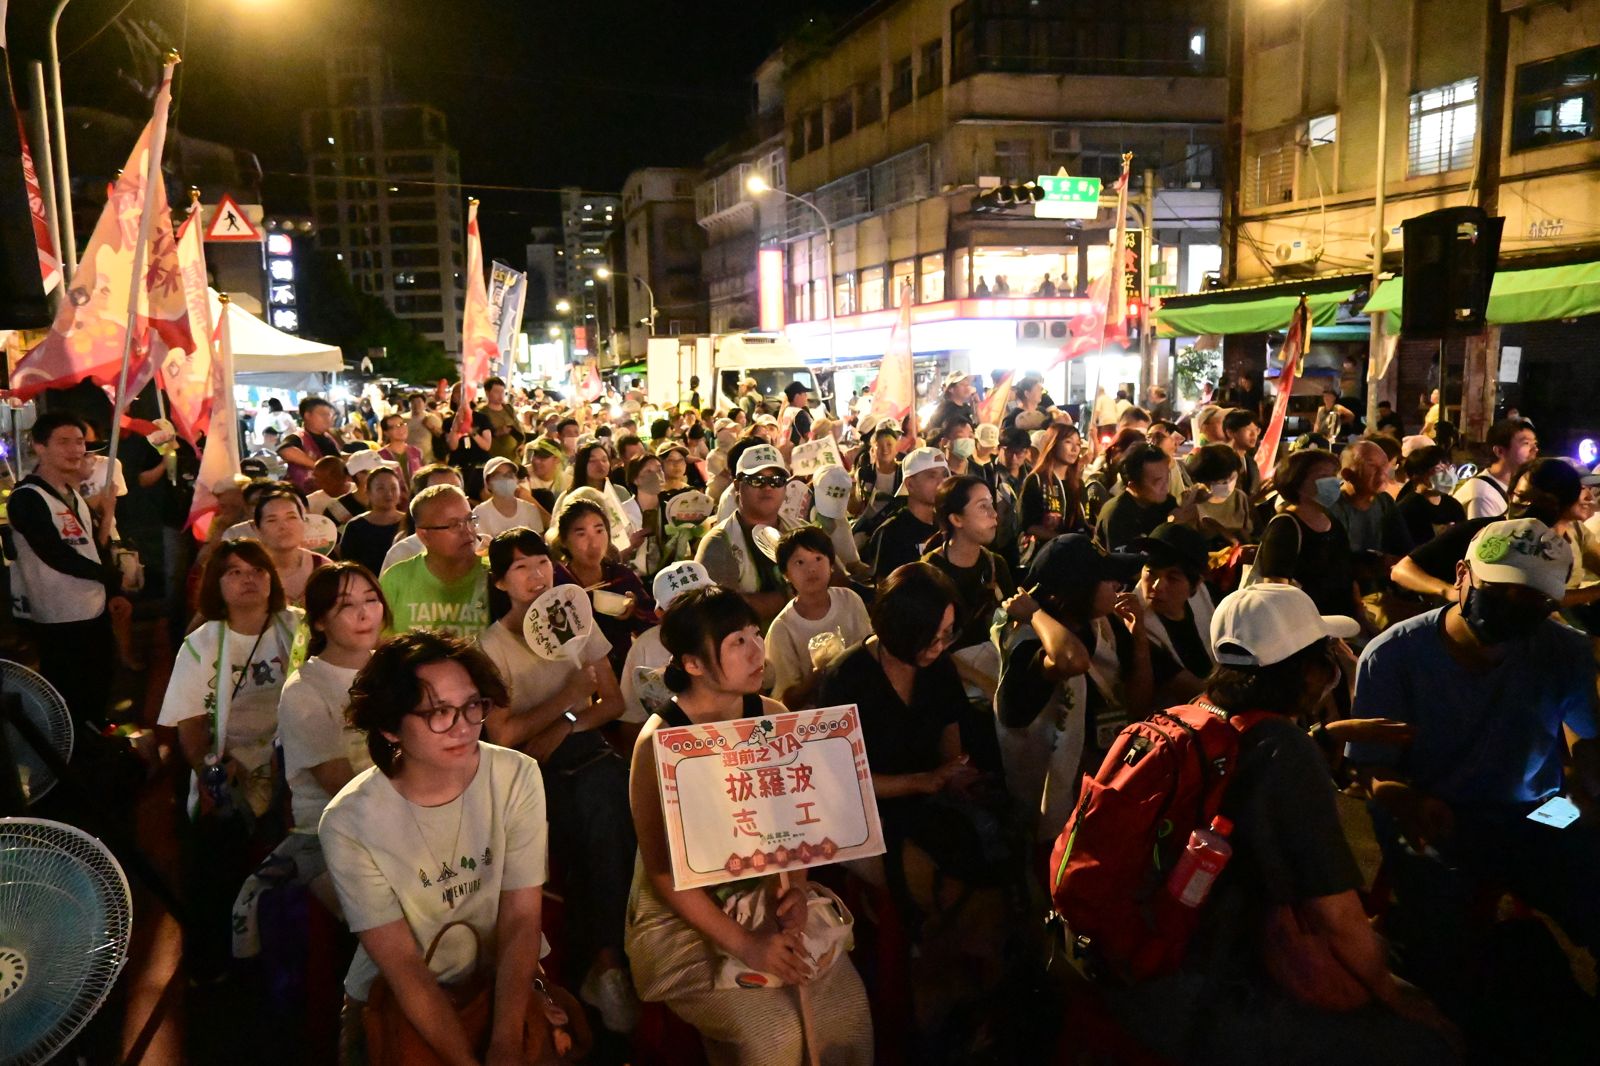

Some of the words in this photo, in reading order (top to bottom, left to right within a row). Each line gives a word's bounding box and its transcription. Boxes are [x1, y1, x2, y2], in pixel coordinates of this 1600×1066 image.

[725, 763, 816, 802] 拔羅波
[442, 879, 481, 903] AENTURE
